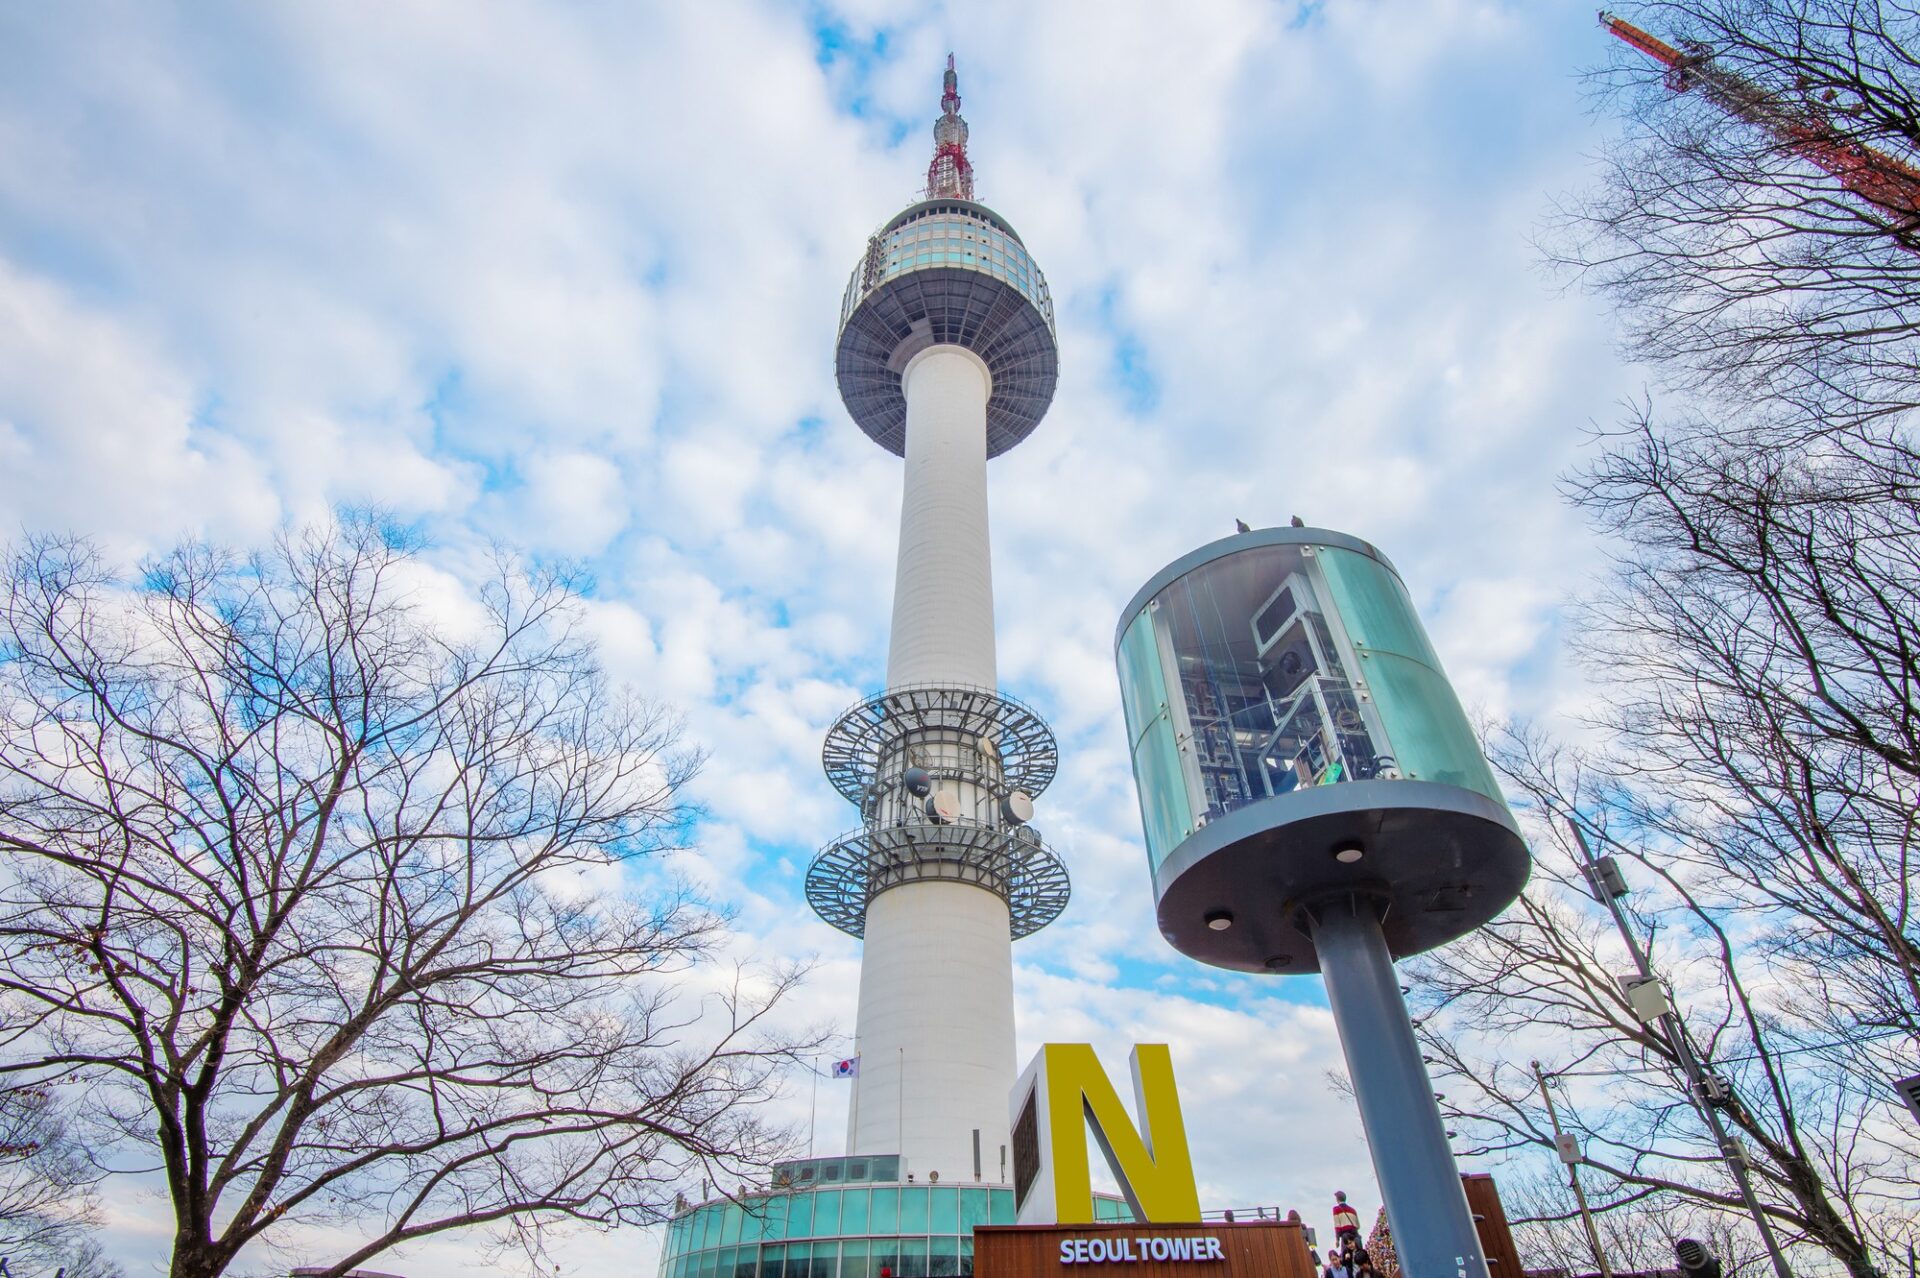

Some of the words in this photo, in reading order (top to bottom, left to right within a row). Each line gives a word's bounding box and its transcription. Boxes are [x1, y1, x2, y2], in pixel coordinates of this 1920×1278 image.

[1043, 1042, 1203, 1224] N
[1060, 1238, 1137, 1264] SEOUL
[1135, 1236, 1226, 1262] TOWER
